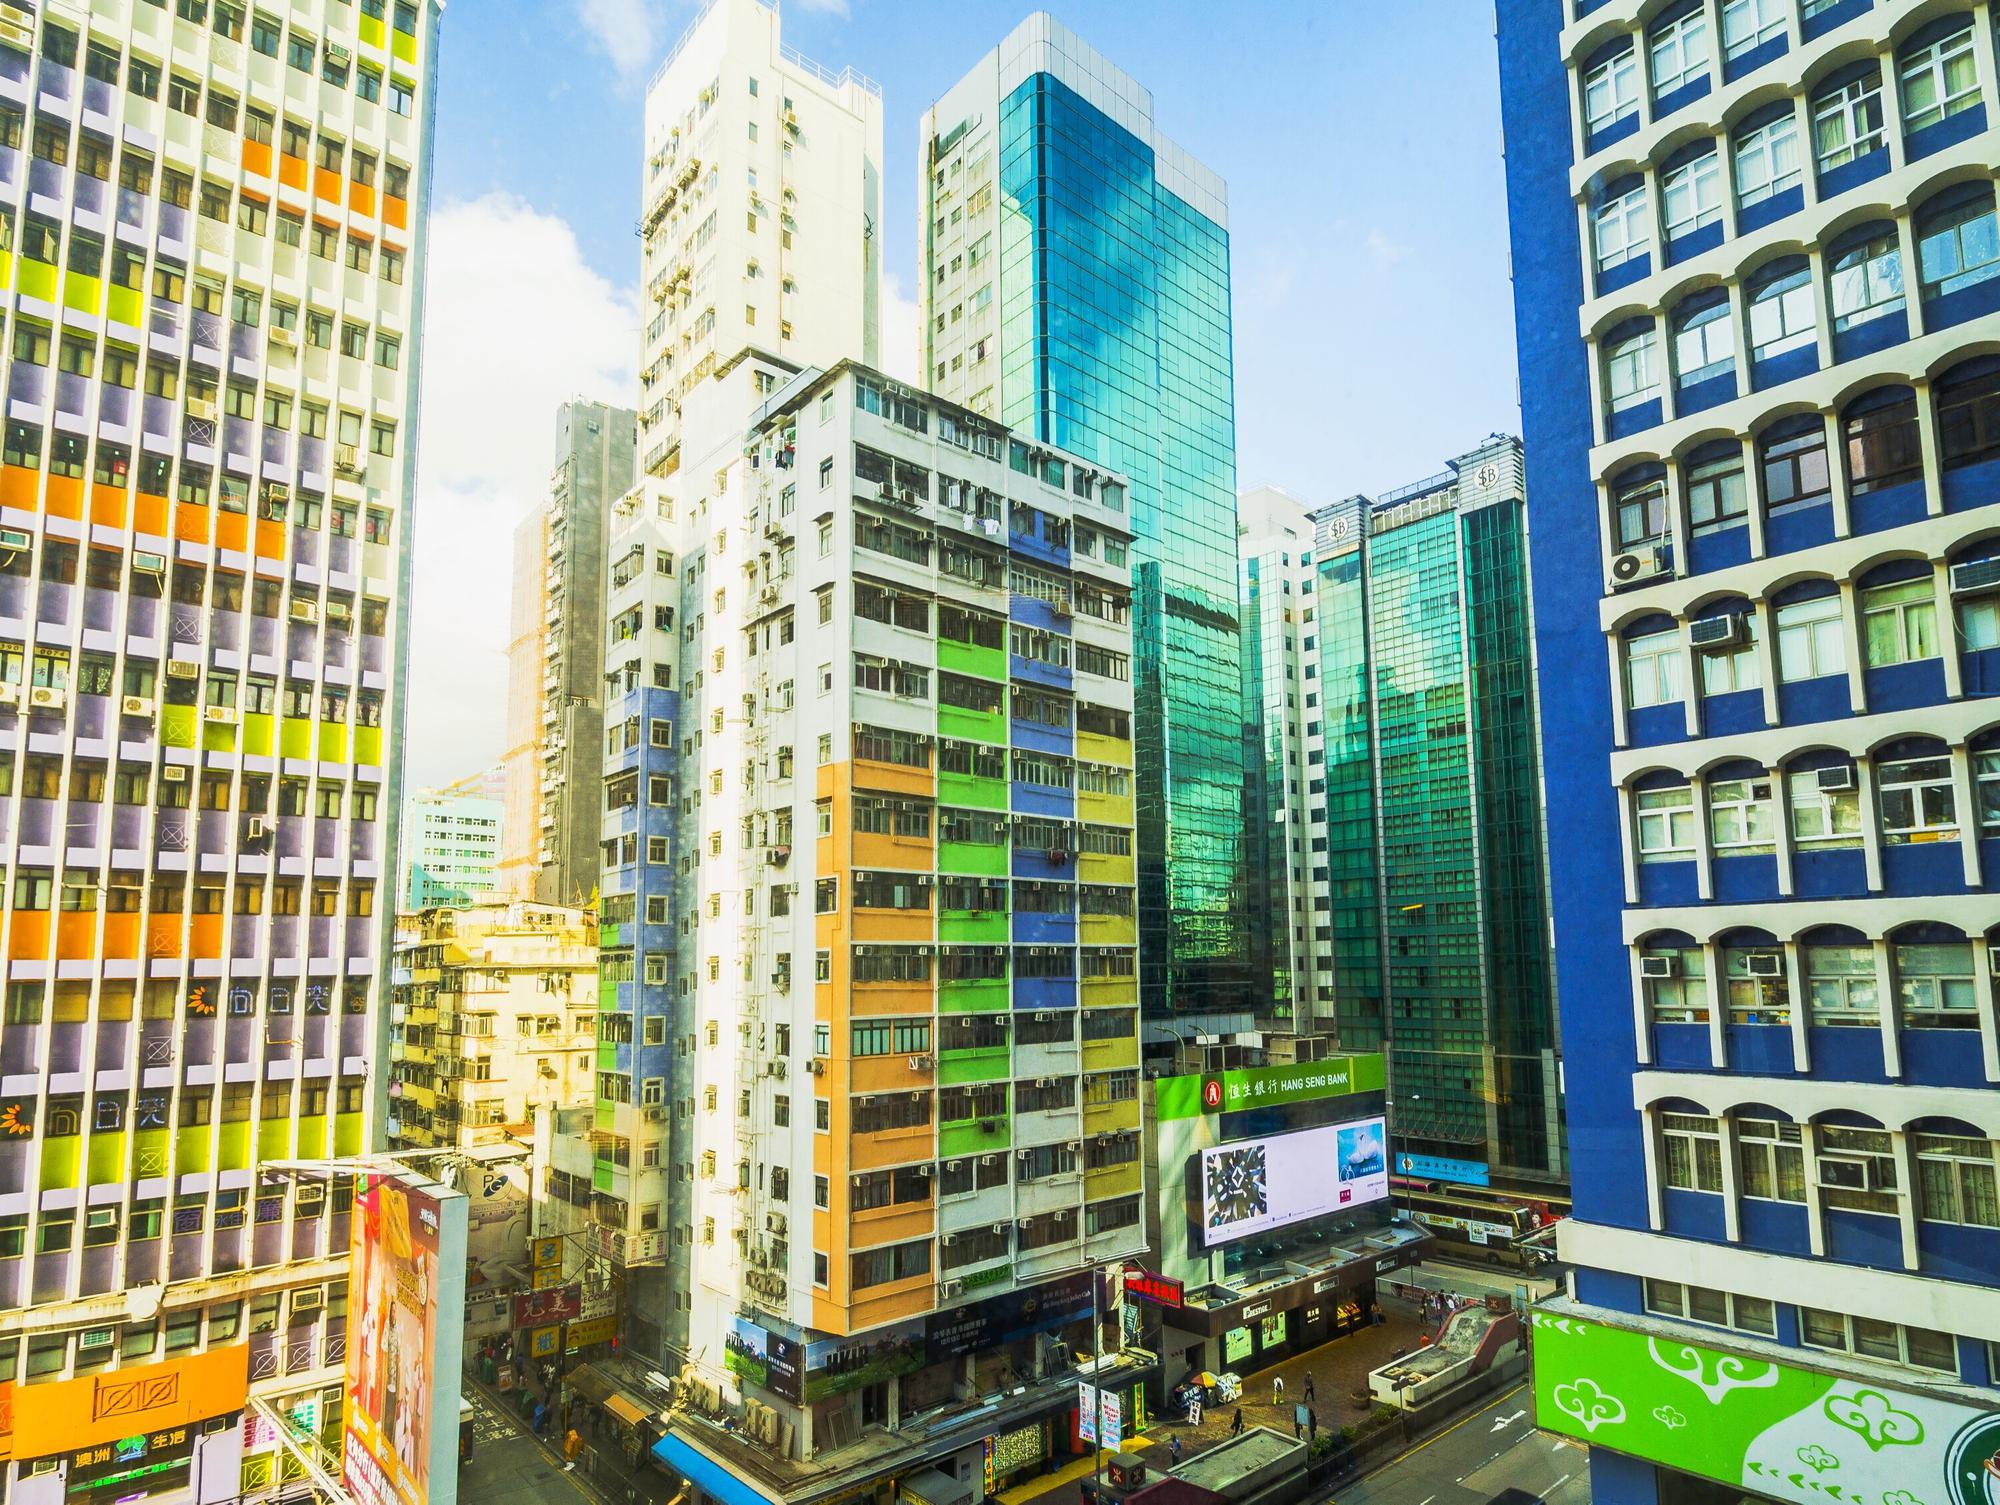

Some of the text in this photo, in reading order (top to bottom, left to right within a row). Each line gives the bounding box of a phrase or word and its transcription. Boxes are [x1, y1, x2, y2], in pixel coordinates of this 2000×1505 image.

[1281, 1072, 1348, 1091] HANG SENG BANK
[75, 1430, 186, 1468] 澳洲 生活
